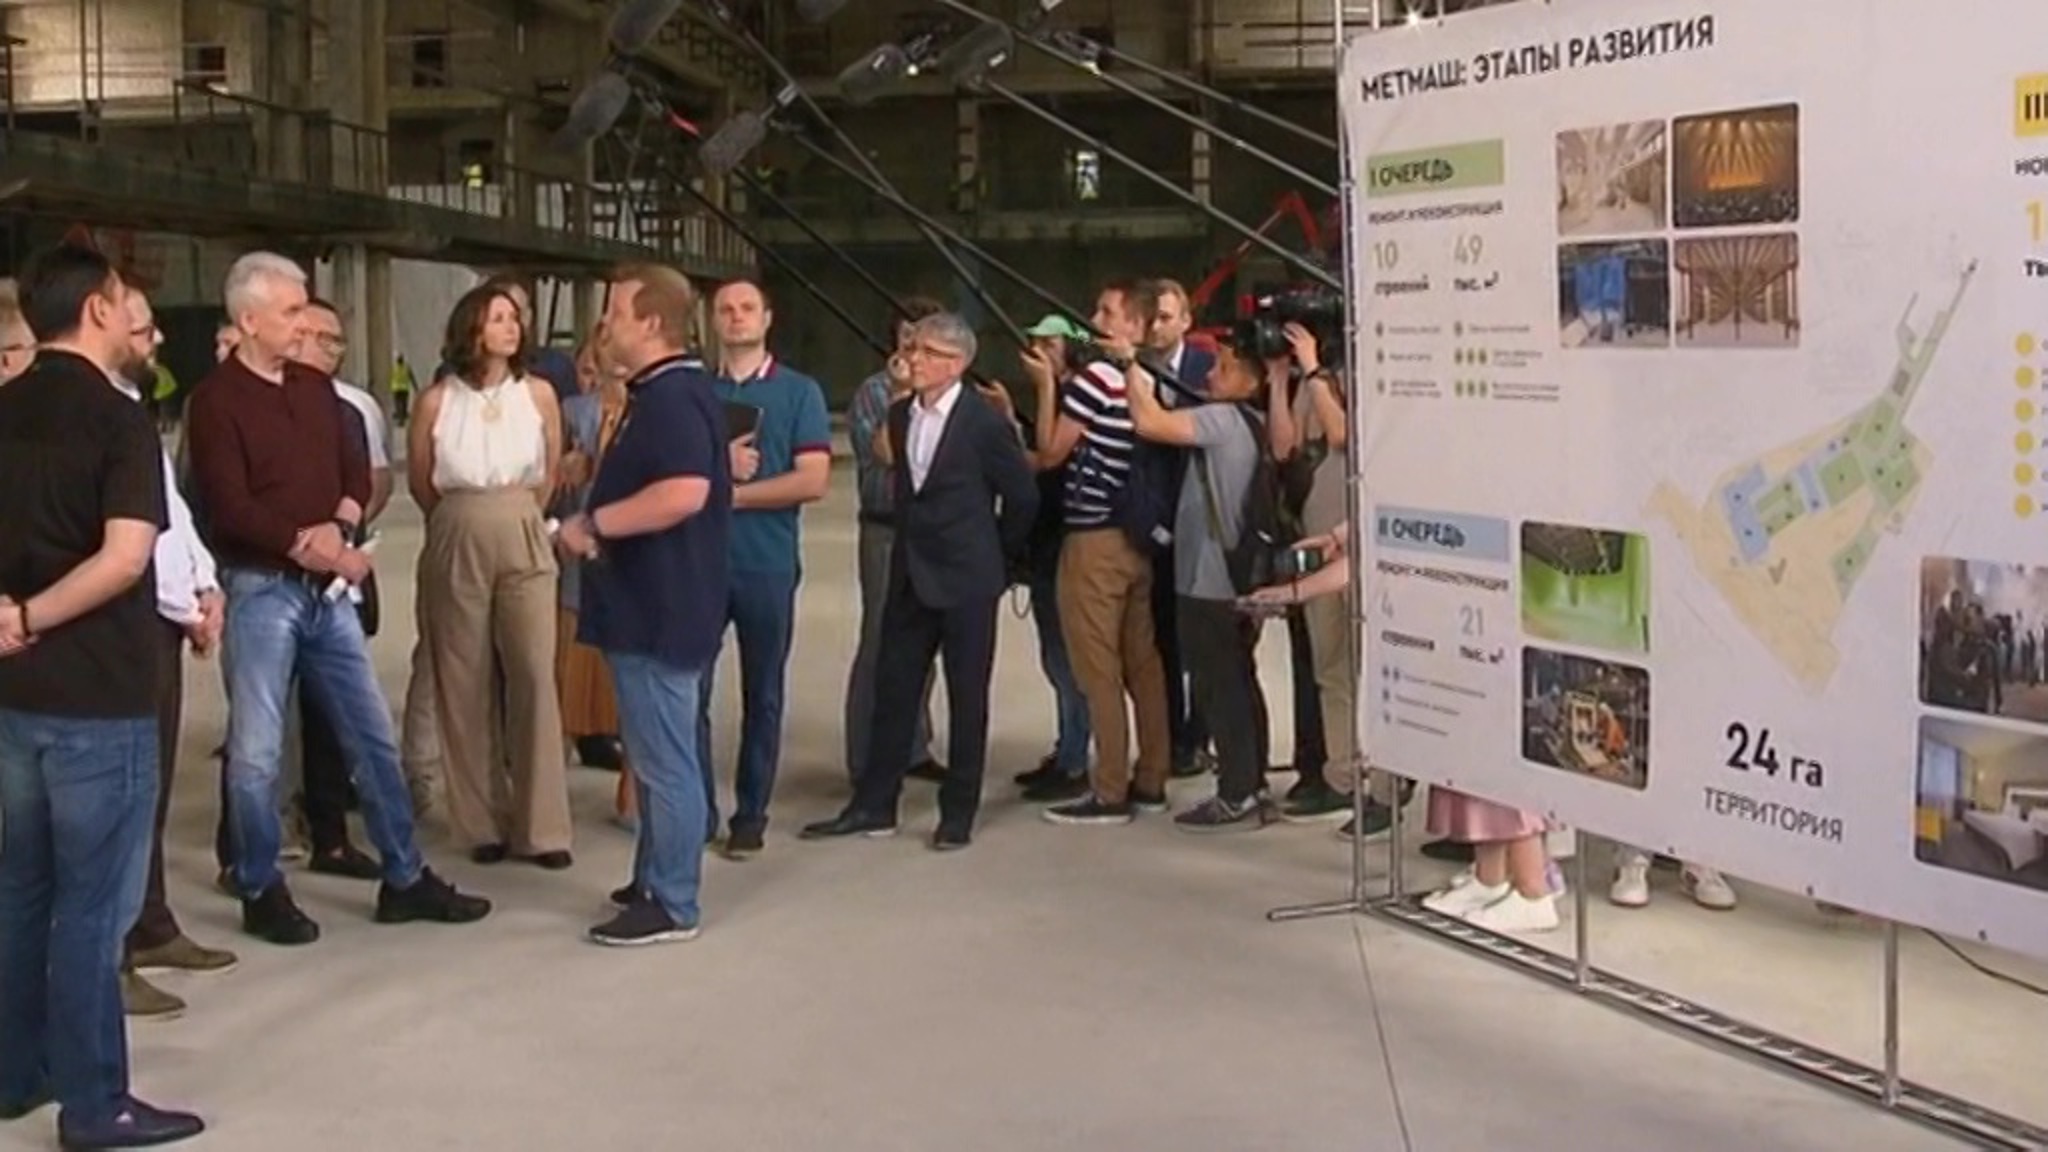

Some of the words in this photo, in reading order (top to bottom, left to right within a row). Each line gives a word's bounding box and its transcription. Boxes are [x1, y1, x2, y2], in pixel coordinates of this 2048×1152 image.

[1361, 58, 1467, 102] МЕТМАШ:
[1473, 45, 1560, 84] ЭТАПЫ
[1568, 14, 1715, 68] РАЗВИТИЯ
[1379, 158, 1454, 188] ОЧЕРЕДЬ
[1374, 239, 1399, 270] 10
[1454, 233, 1484, 265] 49
[1391, 517, 1466, 549] ОЧЕРЕДЬ
[1459, 603, 1485, 637] 21
[1725, 721, 1780, 777] 24
[1790, 755, 1823, 788] га
[1704, 786, 1843, 844] ТЕРРИТОРИЯ
